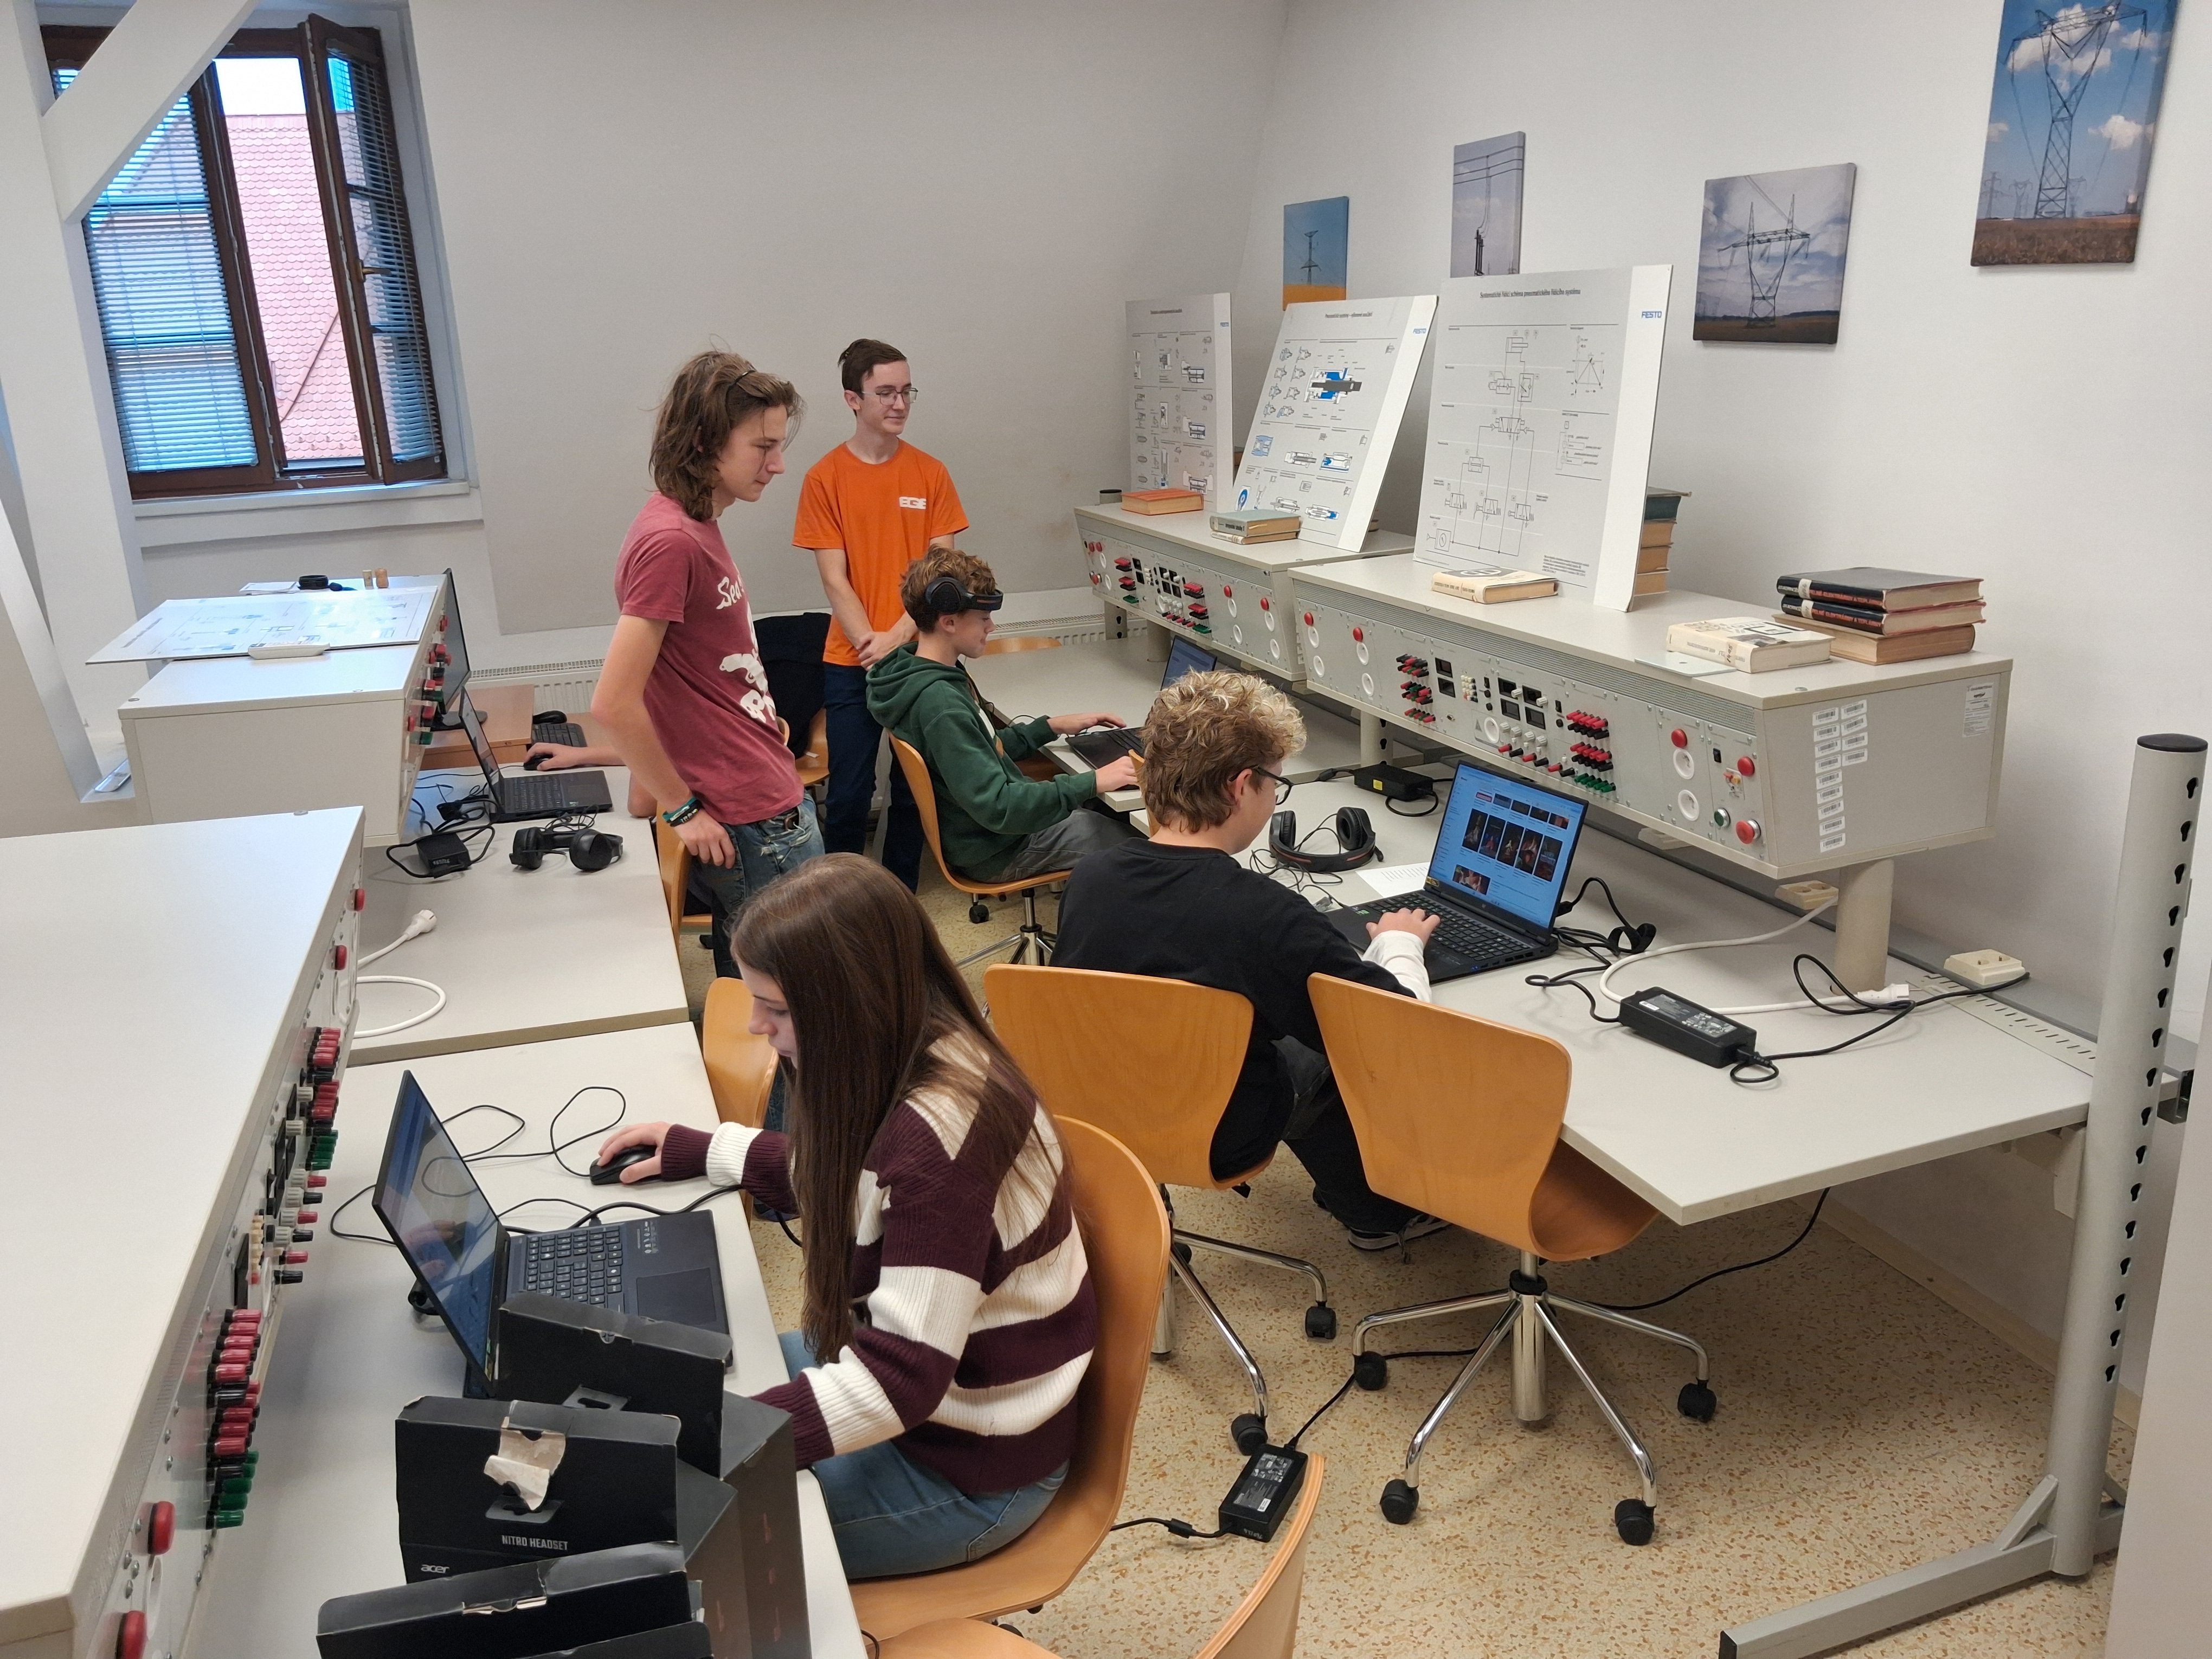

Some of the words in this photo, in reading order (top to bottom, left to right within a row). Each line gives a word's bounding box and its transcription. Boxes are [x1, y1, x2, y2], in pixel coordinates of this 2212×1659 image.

[501, 1534, 528, 1547] NITRO
[529, 1538, 568, 1551] HEADSET
[421, 1564, 450, 1573] acer
